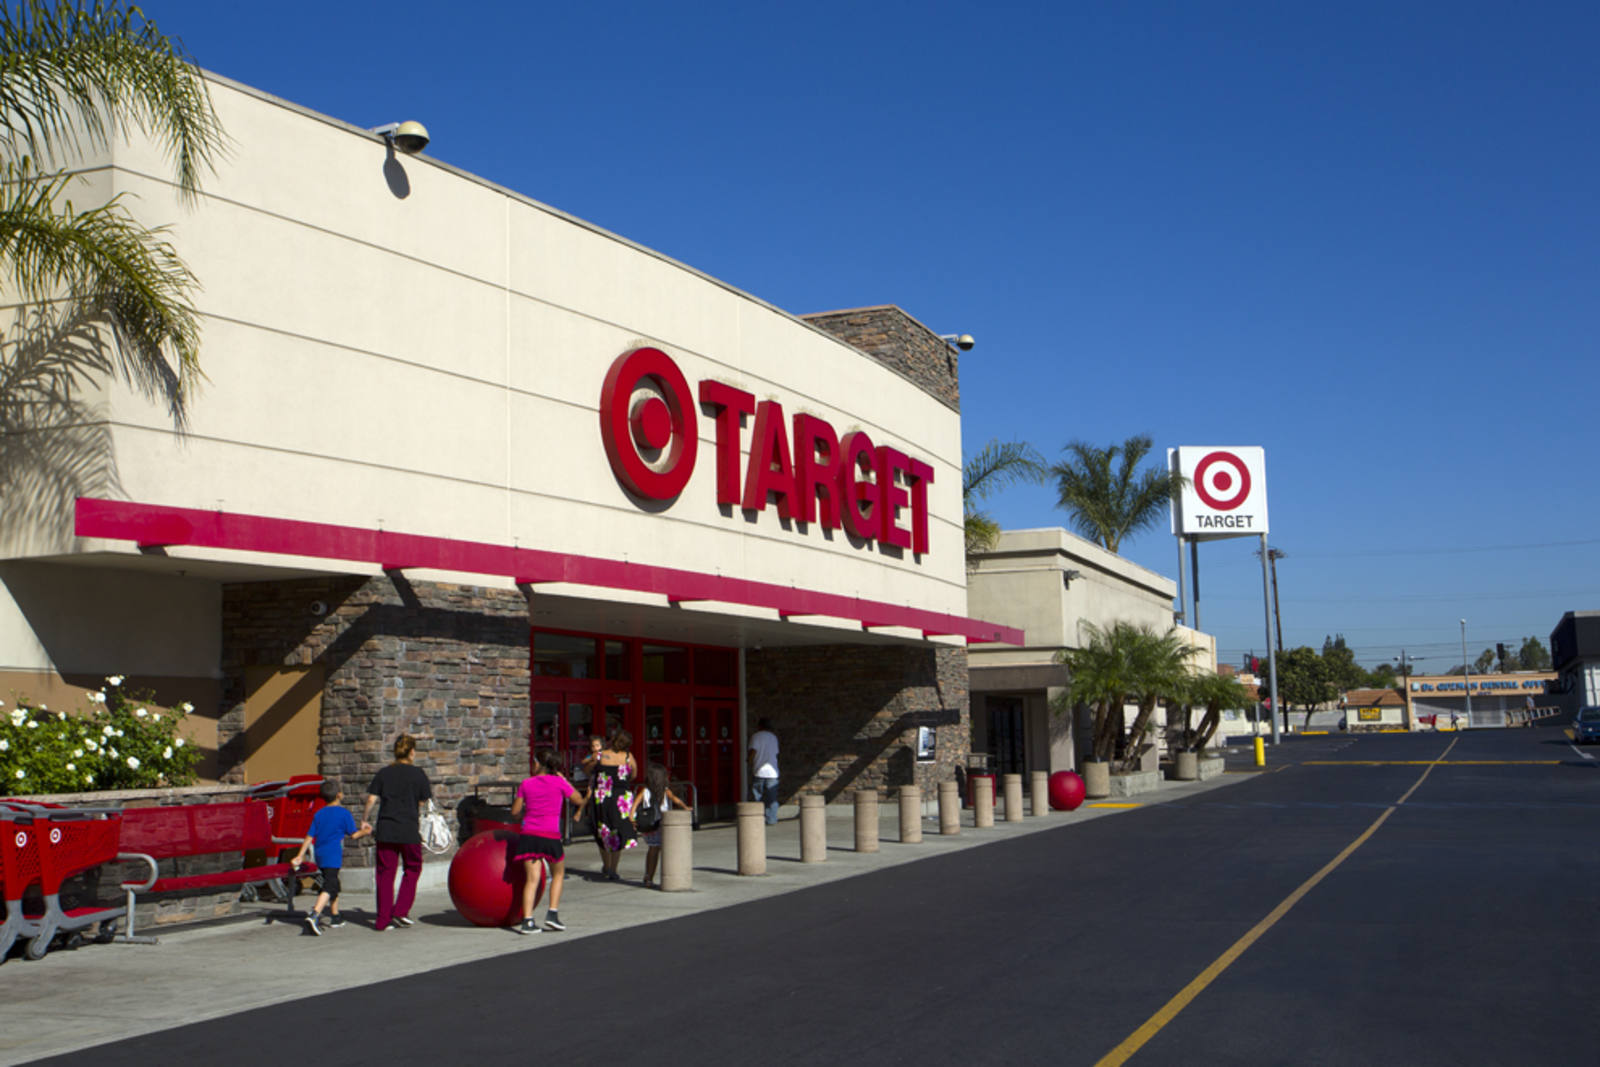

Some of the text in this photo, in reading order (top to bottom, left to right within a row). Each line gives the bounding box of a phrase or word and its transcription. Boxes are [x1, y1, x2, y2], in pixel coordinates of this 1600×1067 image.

[699, 379, 934, 554] TARGET
[1195, 515, 1253, 528] TARGET
[1480, 681, 1519, 690] DENTAL
